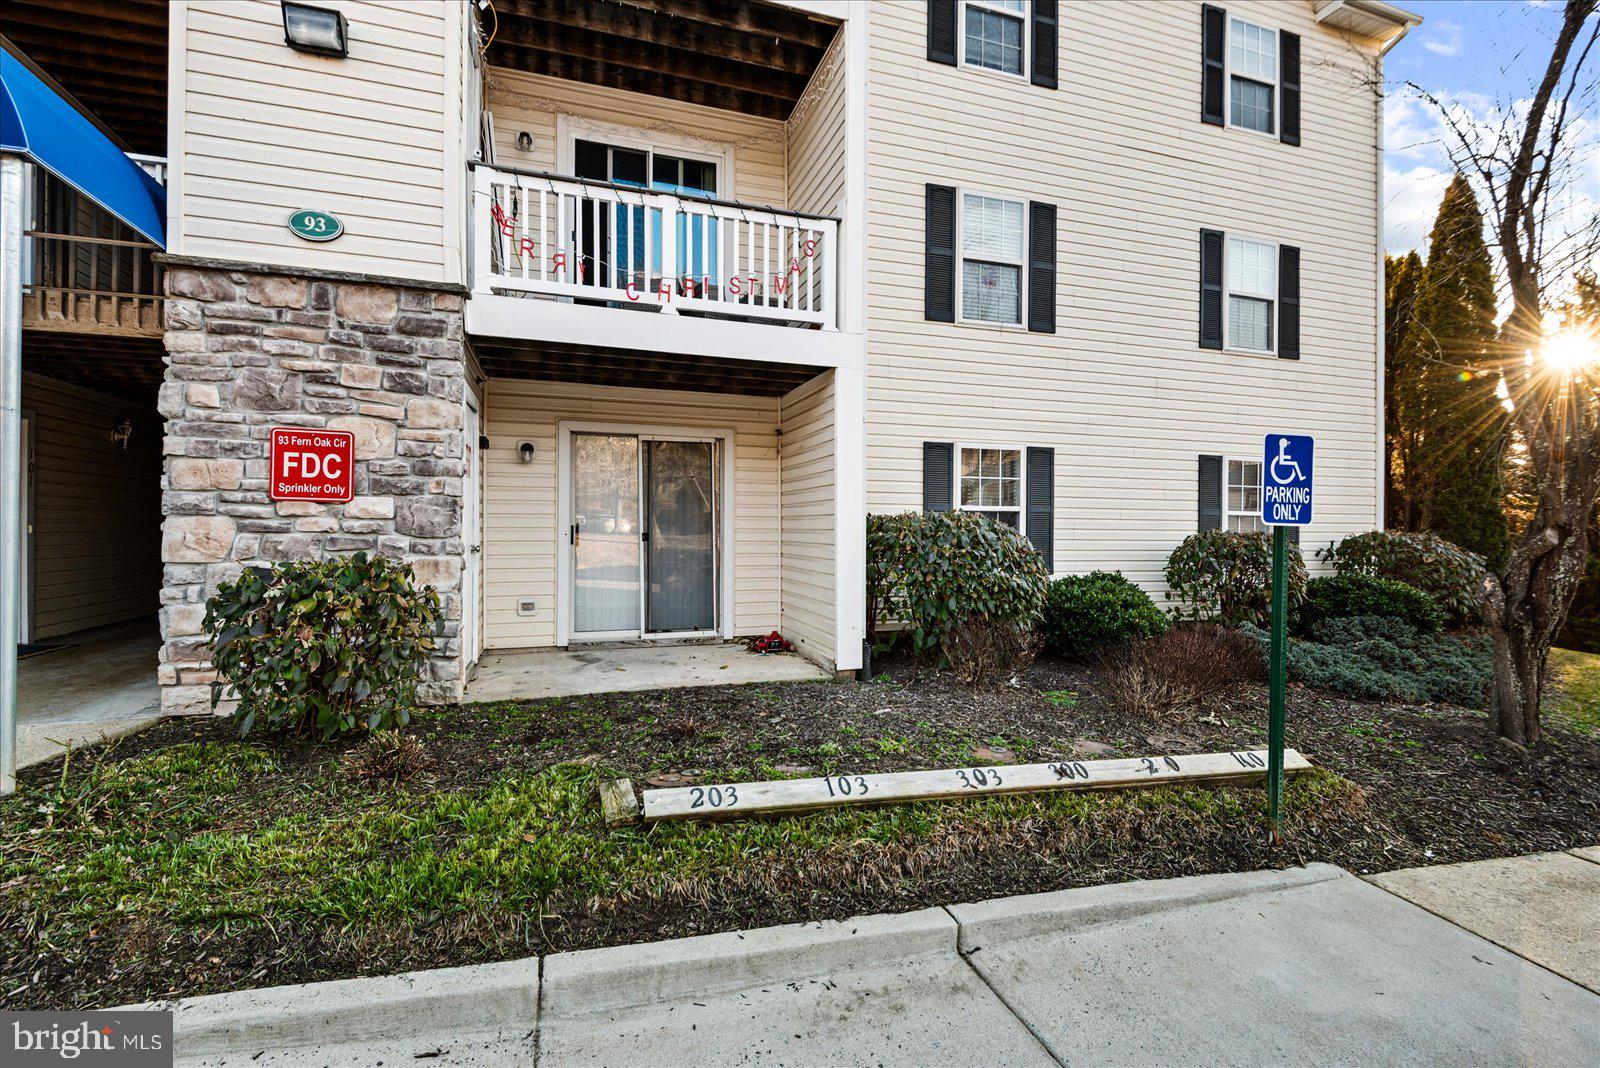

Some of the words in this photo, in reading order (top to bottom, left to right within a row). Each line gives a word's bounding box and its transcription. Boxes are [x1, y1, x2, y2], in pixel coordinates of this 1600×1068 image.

[304, 216, 326, 232] 93
[278, 435, 289, 445] 93
[291, 436, 312, 446] Fern
[313, 437, 332, 447] Oak
[333, 438, 347, 448] Cir
[283, 451, 342, 479] FDC
[278, 482, 322, 494] Sprinkler
[323, 484, 346, 496] Only
[1265, 486, 1310, 504] PARKING
[1273, 503, 1302, 520] ONLY
[689, 786, 739, 809] 203
[823, 776, 869, 798] 103
[955, 768, 1003, 787] 303
